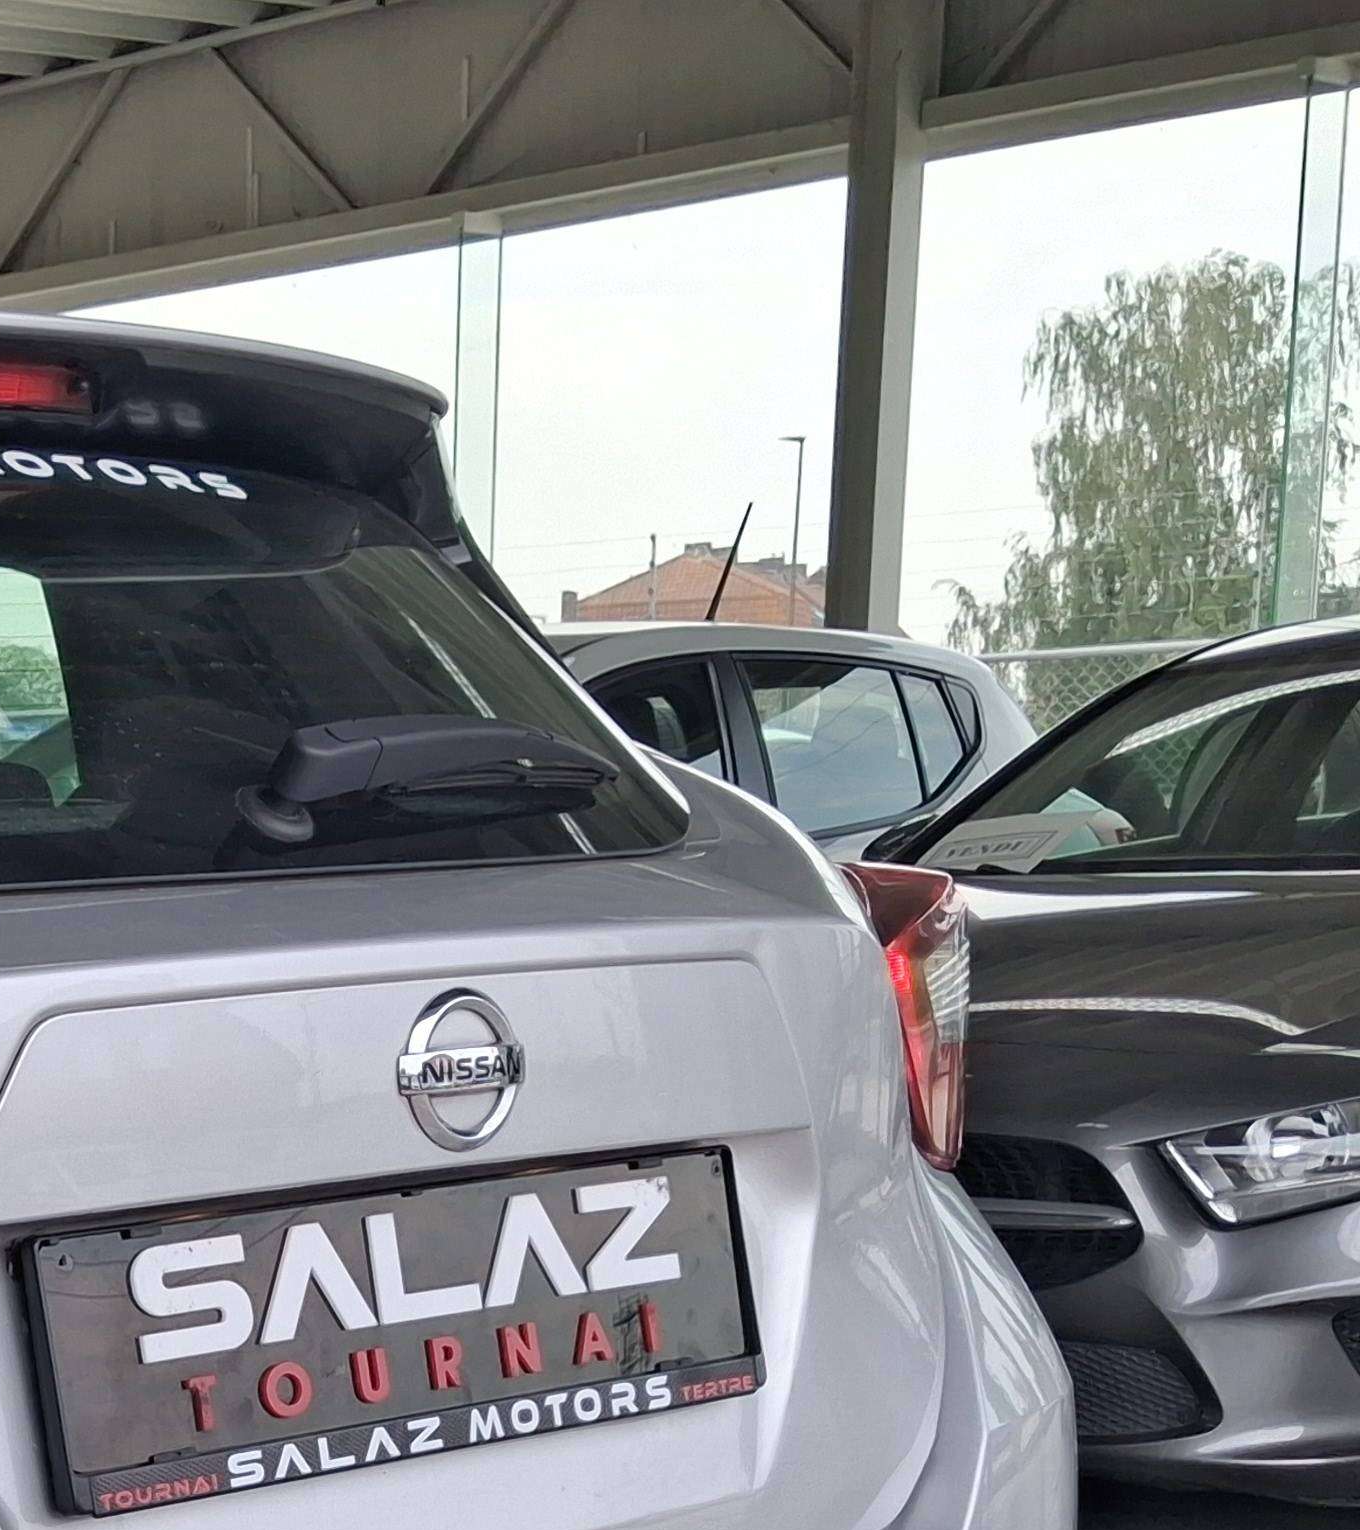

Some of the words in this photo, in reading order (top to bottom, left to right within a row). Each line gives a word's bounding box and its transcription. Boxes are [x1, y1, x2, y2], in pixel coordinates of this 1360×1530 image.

[419, 1046, 521, 1084] NISSAN
[128, 1176, 682, 1363] SALAZ
[181, 1302, 663, 1432] TOURNAI
[99, 1474, 220, 1511] TOURNAI
[226, 1416, 445, 1489] SALAZ
[469, 1375, 672, 1443] MOTORS
[681, 1374, 755, 1402] TERTRE
